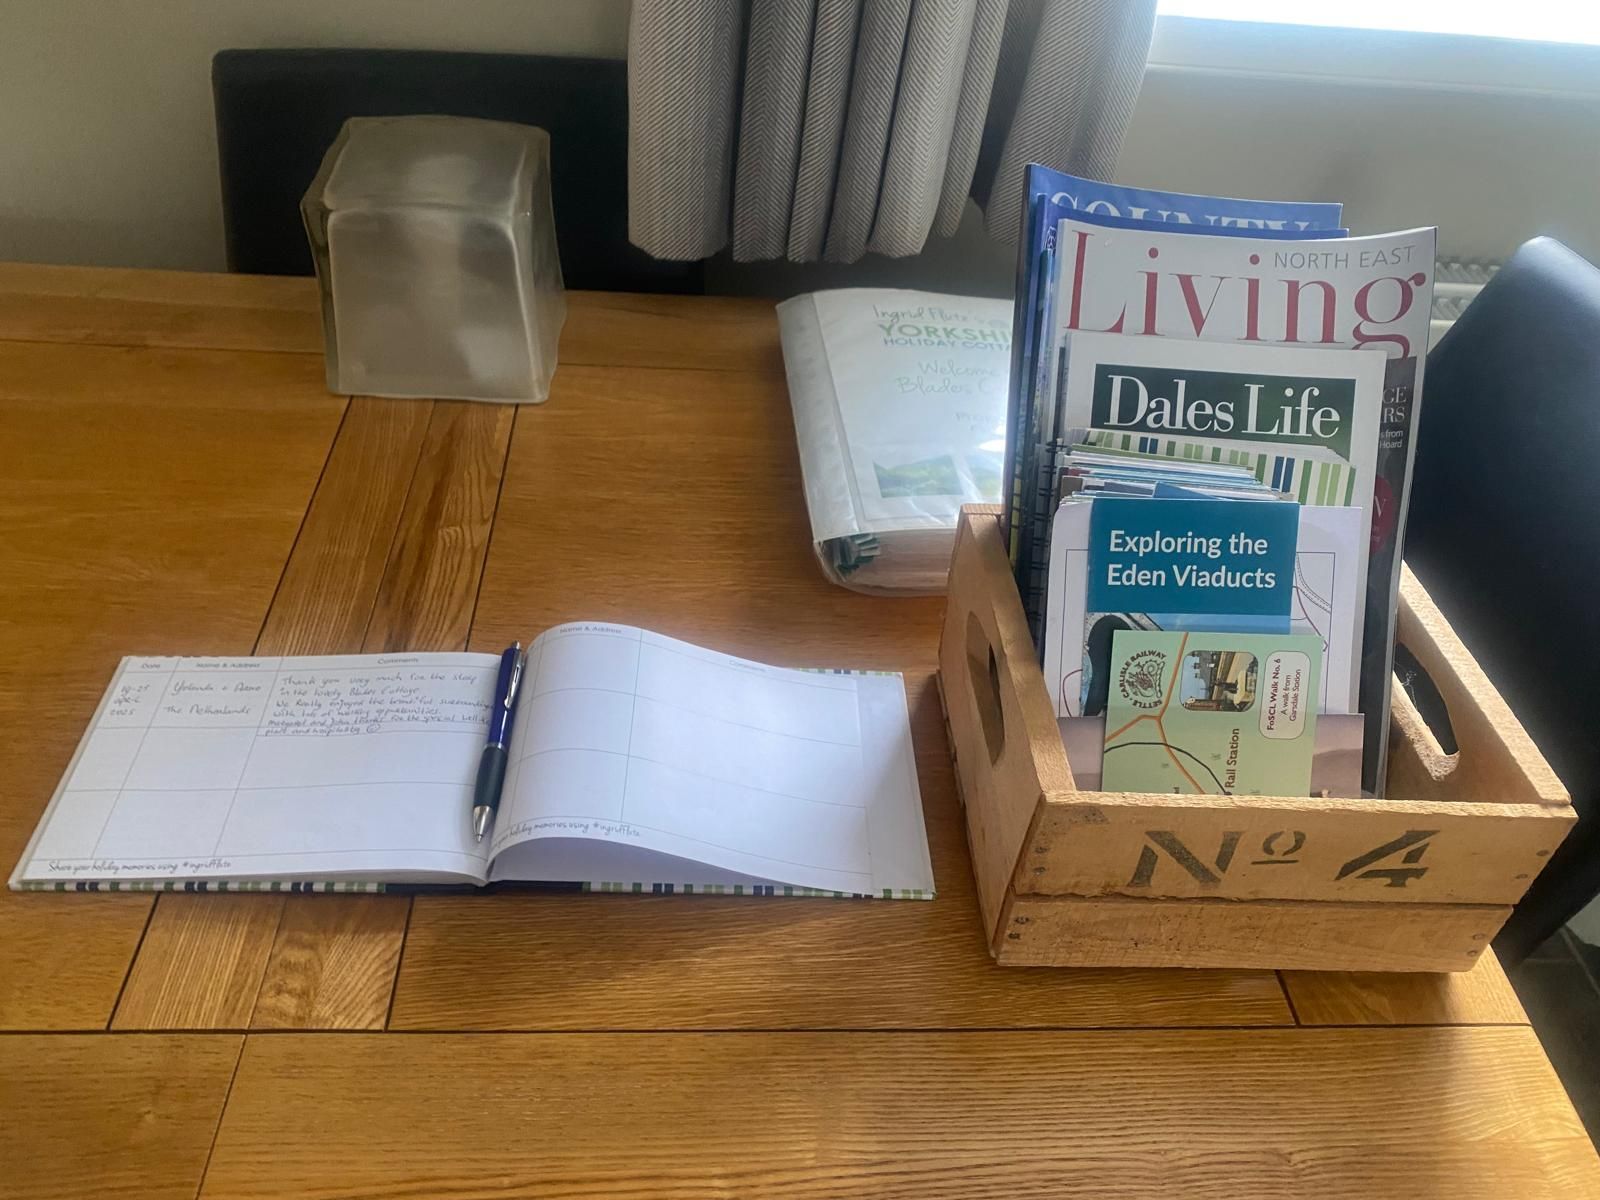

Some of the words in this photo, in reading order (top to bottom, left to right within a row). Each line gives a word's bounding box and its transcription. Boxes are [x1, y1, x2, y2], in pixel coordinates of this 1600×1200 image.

[1273, 250, 1349, 269] NORTH
[1359, 245, 1417, 268] EAST
[1063, 230, 1427, 358] Living
[877, 323, 1012, 343] YORKSHI
[883, 337, 956, 347] HOLIDAY
[1104, 374, 1235, 433] Dales
[1241, 383, 1340, 438] Life
[1109, 530, 1222, 558] Exploring
[1228, 532, 1269, 555] the
[1107, 563, 1166, 586] Eden
[1173, 565, 1276, 589] Viaducts
[1270, 681, 1279, 702] Walk
[1283, 674, 1291, 691] from
[1292, 669, 1302, 692] Station
[1227, 728, 1240, 766] Station
[1225, 769, 1236, 788] Rail
[1334, 830, 1441, 888] 4
